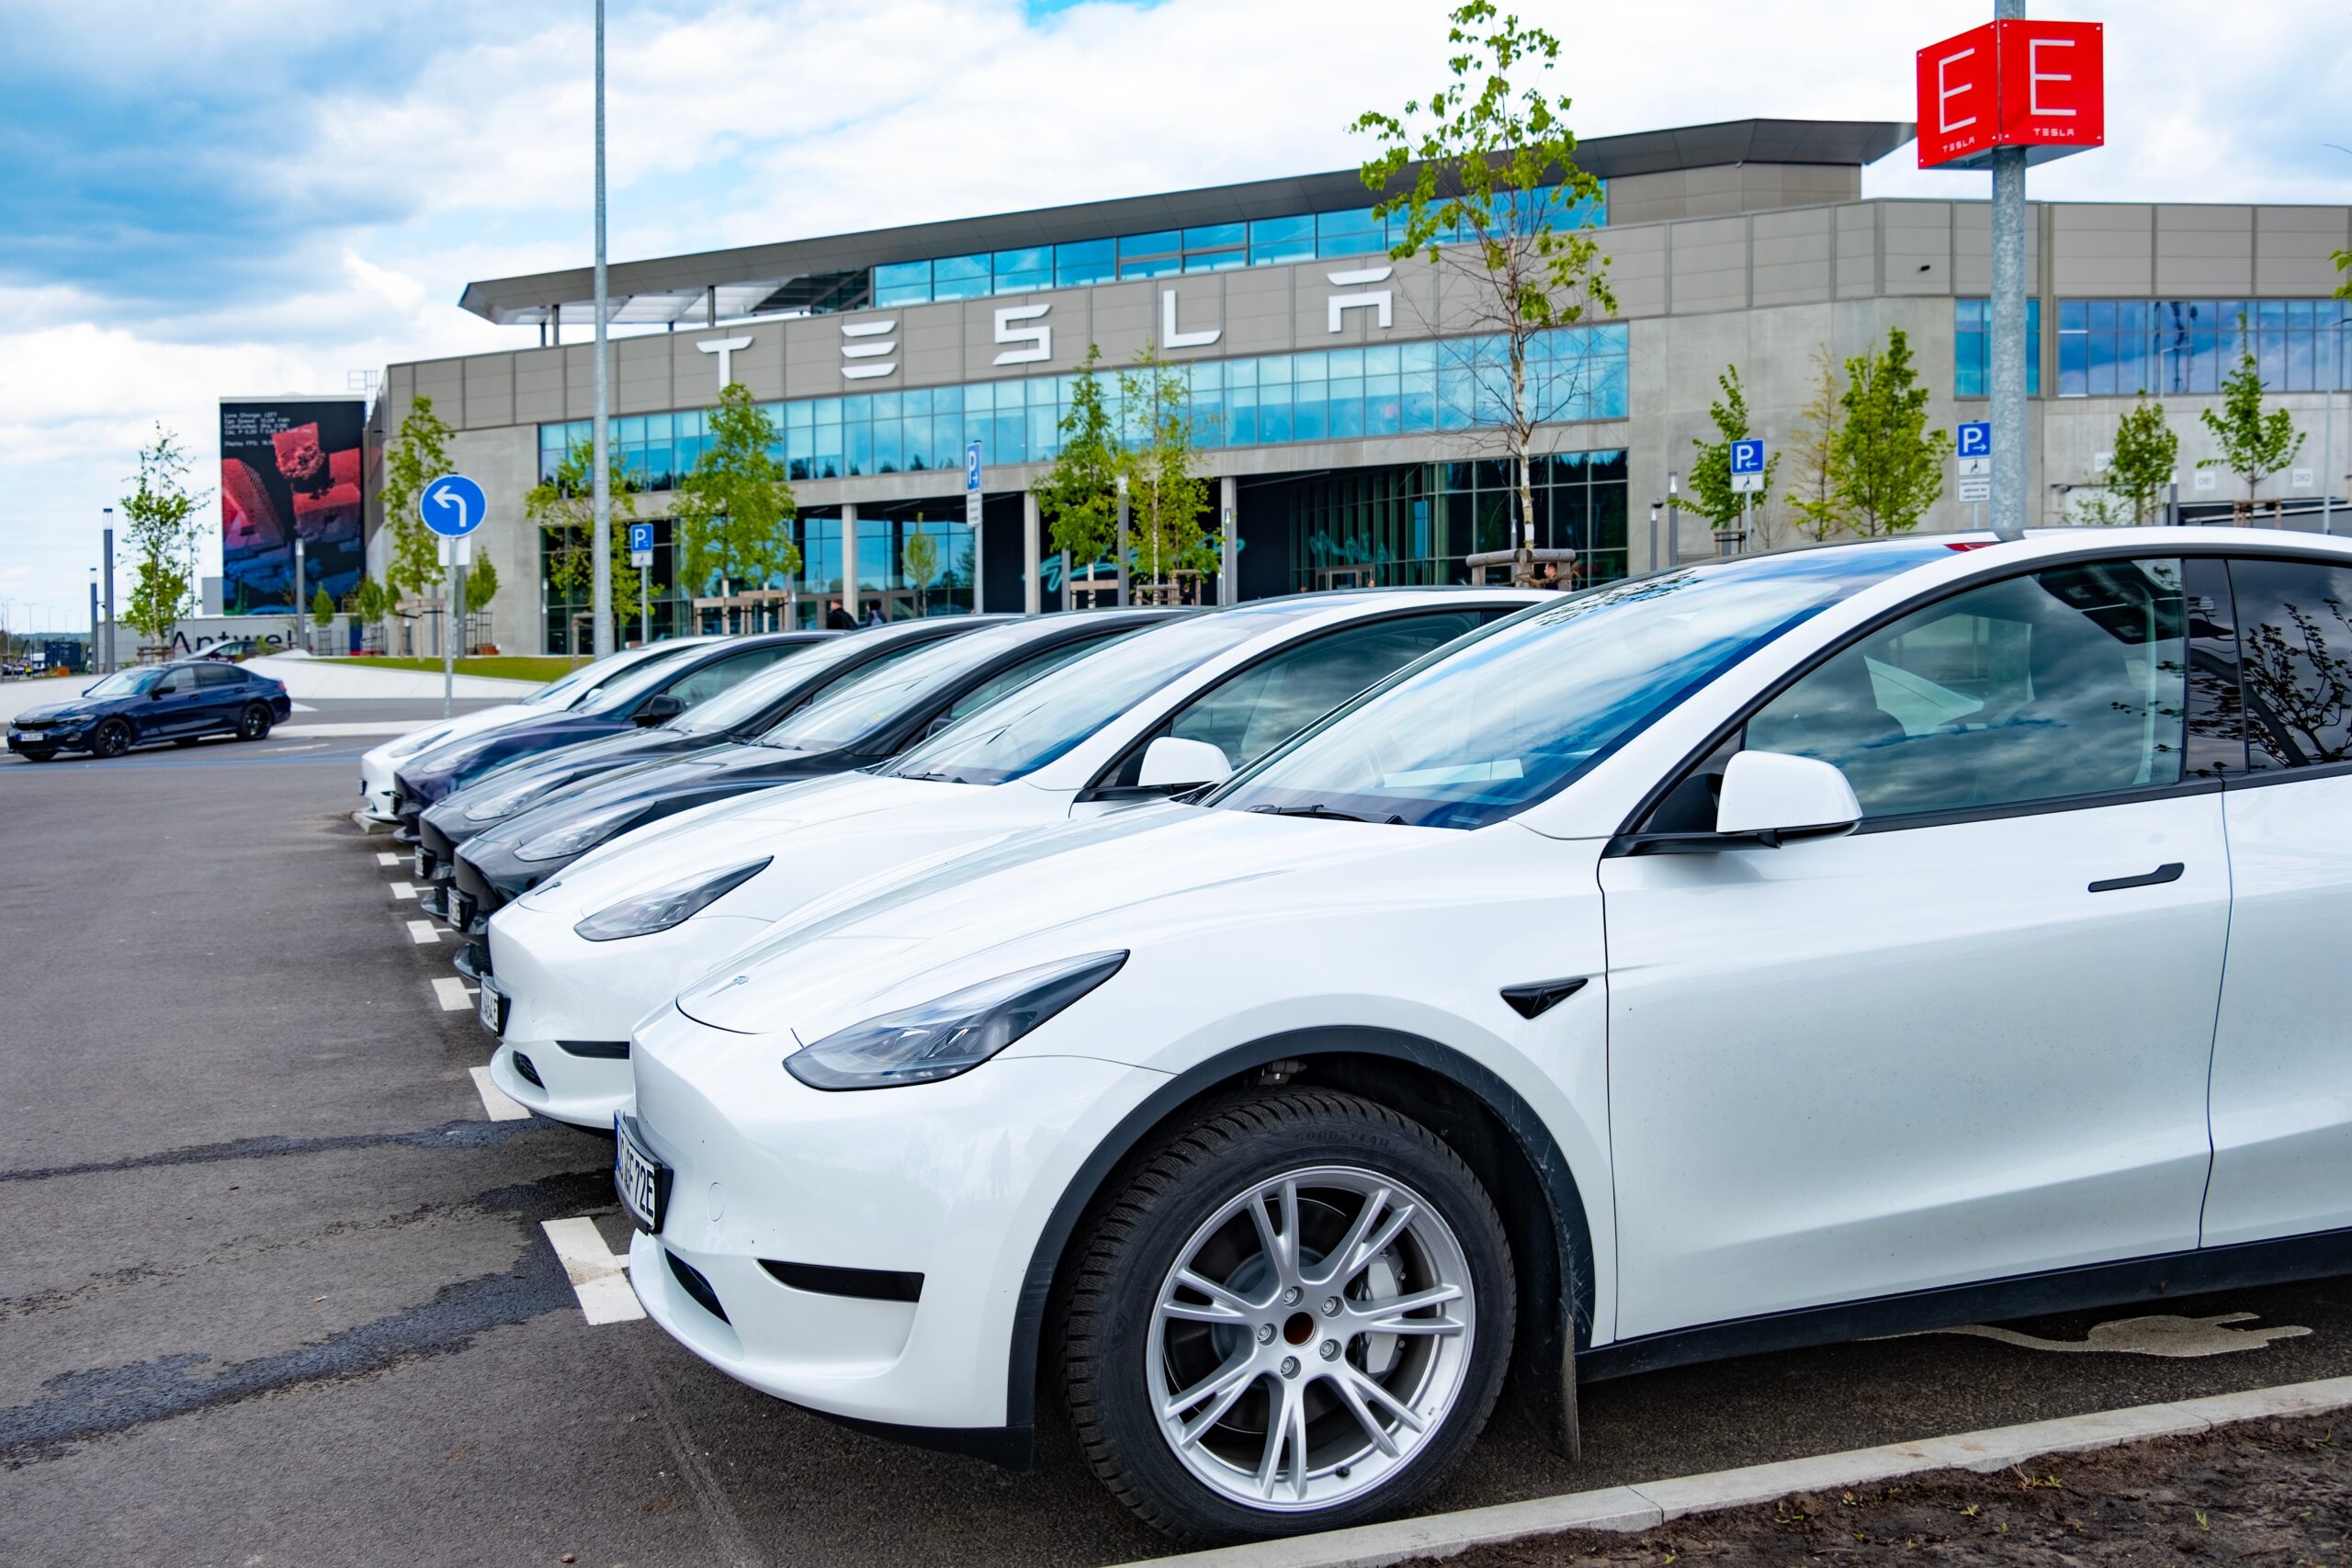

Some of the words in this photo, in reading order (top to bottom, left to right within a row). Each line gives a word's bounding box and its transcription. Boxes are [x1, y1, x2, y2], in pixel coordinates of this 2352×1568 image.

[1939, 47, 1976, 134] E
[2030, 39, 2076, 117] E
[1941, 136, 1976, 153] TESLA
[2033, 127, 2075, 137] TESLA
[695, 265, 1393, 390] TESLA
[1963, 427, 1983, 454] P
[967, 450, 977, 485] P
[1736, 445, 1754, 469] P
[635, 528, 647, 549] P
